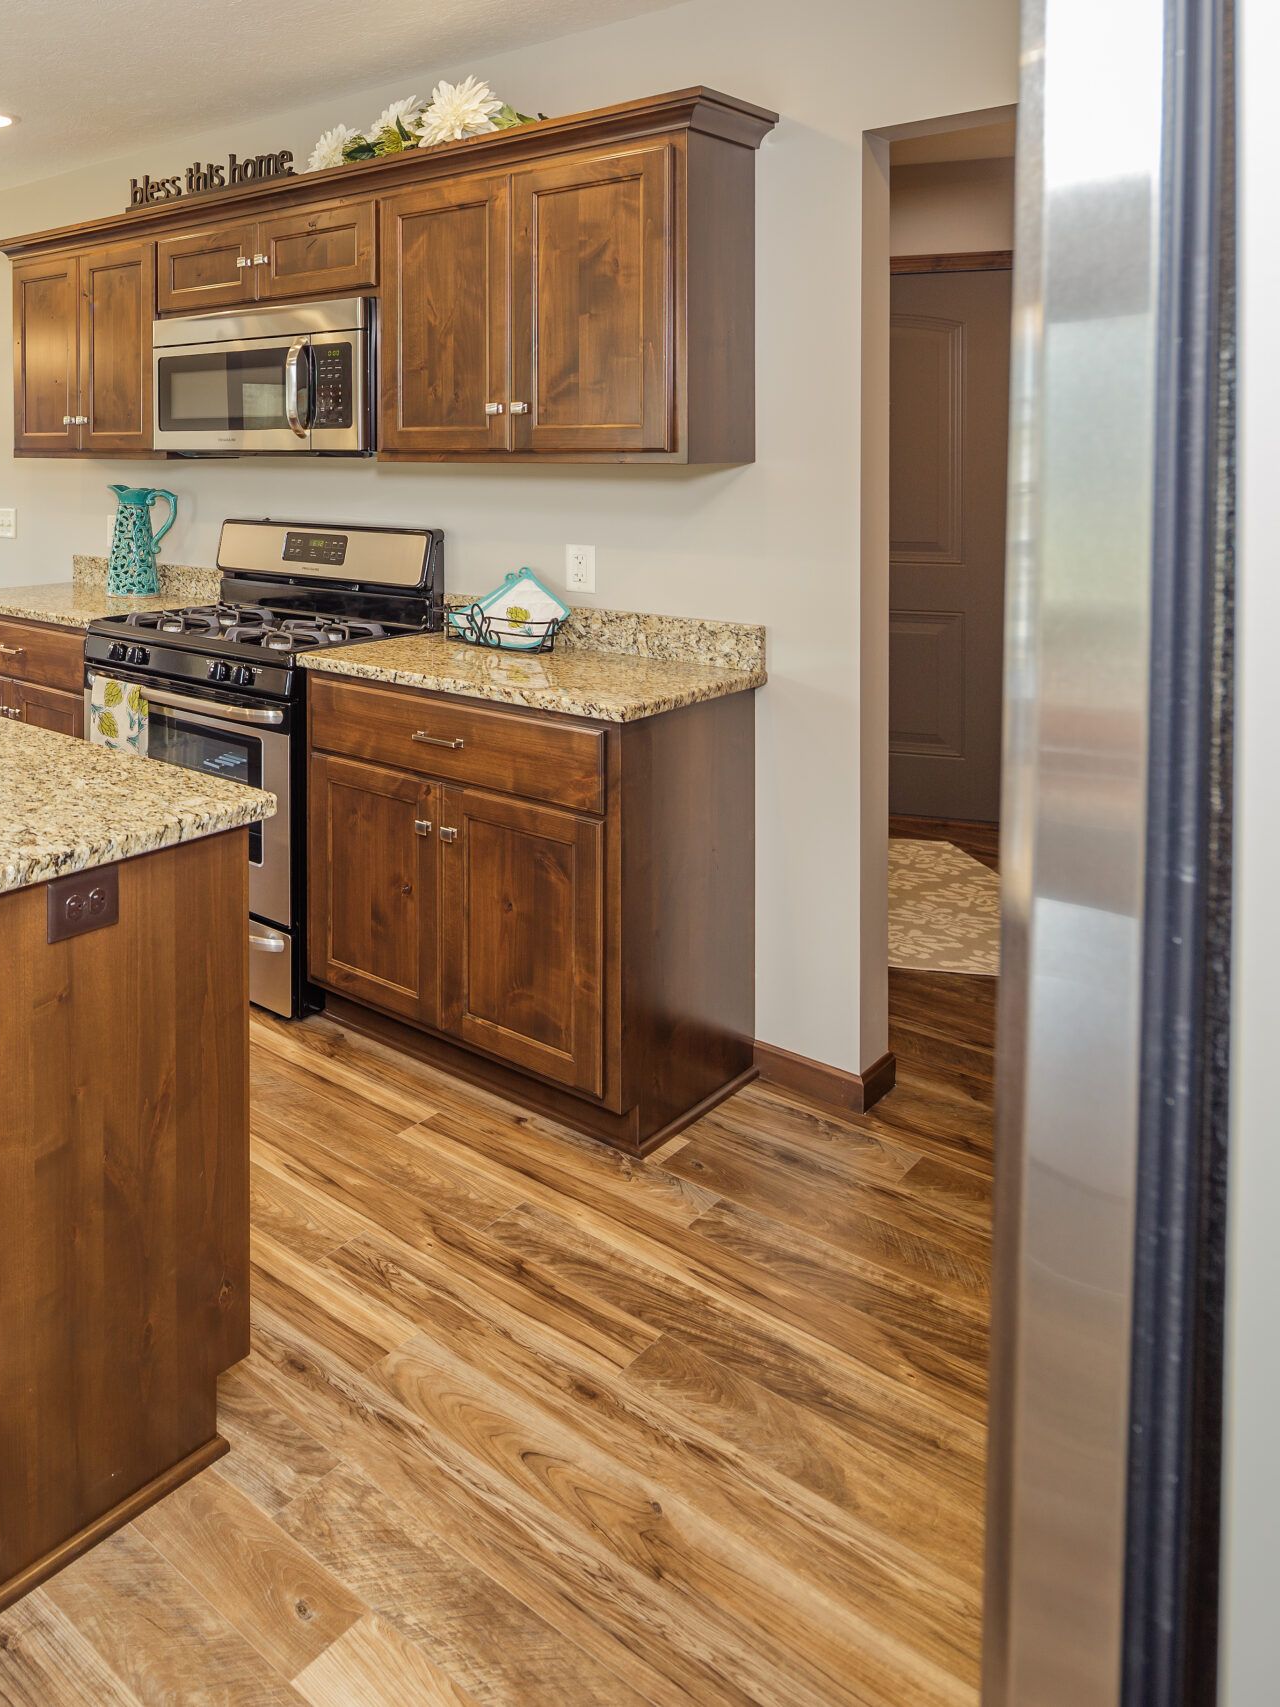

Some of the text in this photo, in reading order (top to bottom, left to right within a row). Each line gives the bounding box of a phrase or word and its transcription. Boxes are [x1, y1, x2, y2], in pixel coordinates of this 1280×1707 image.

[130, 150, 294, 207] bless this home
